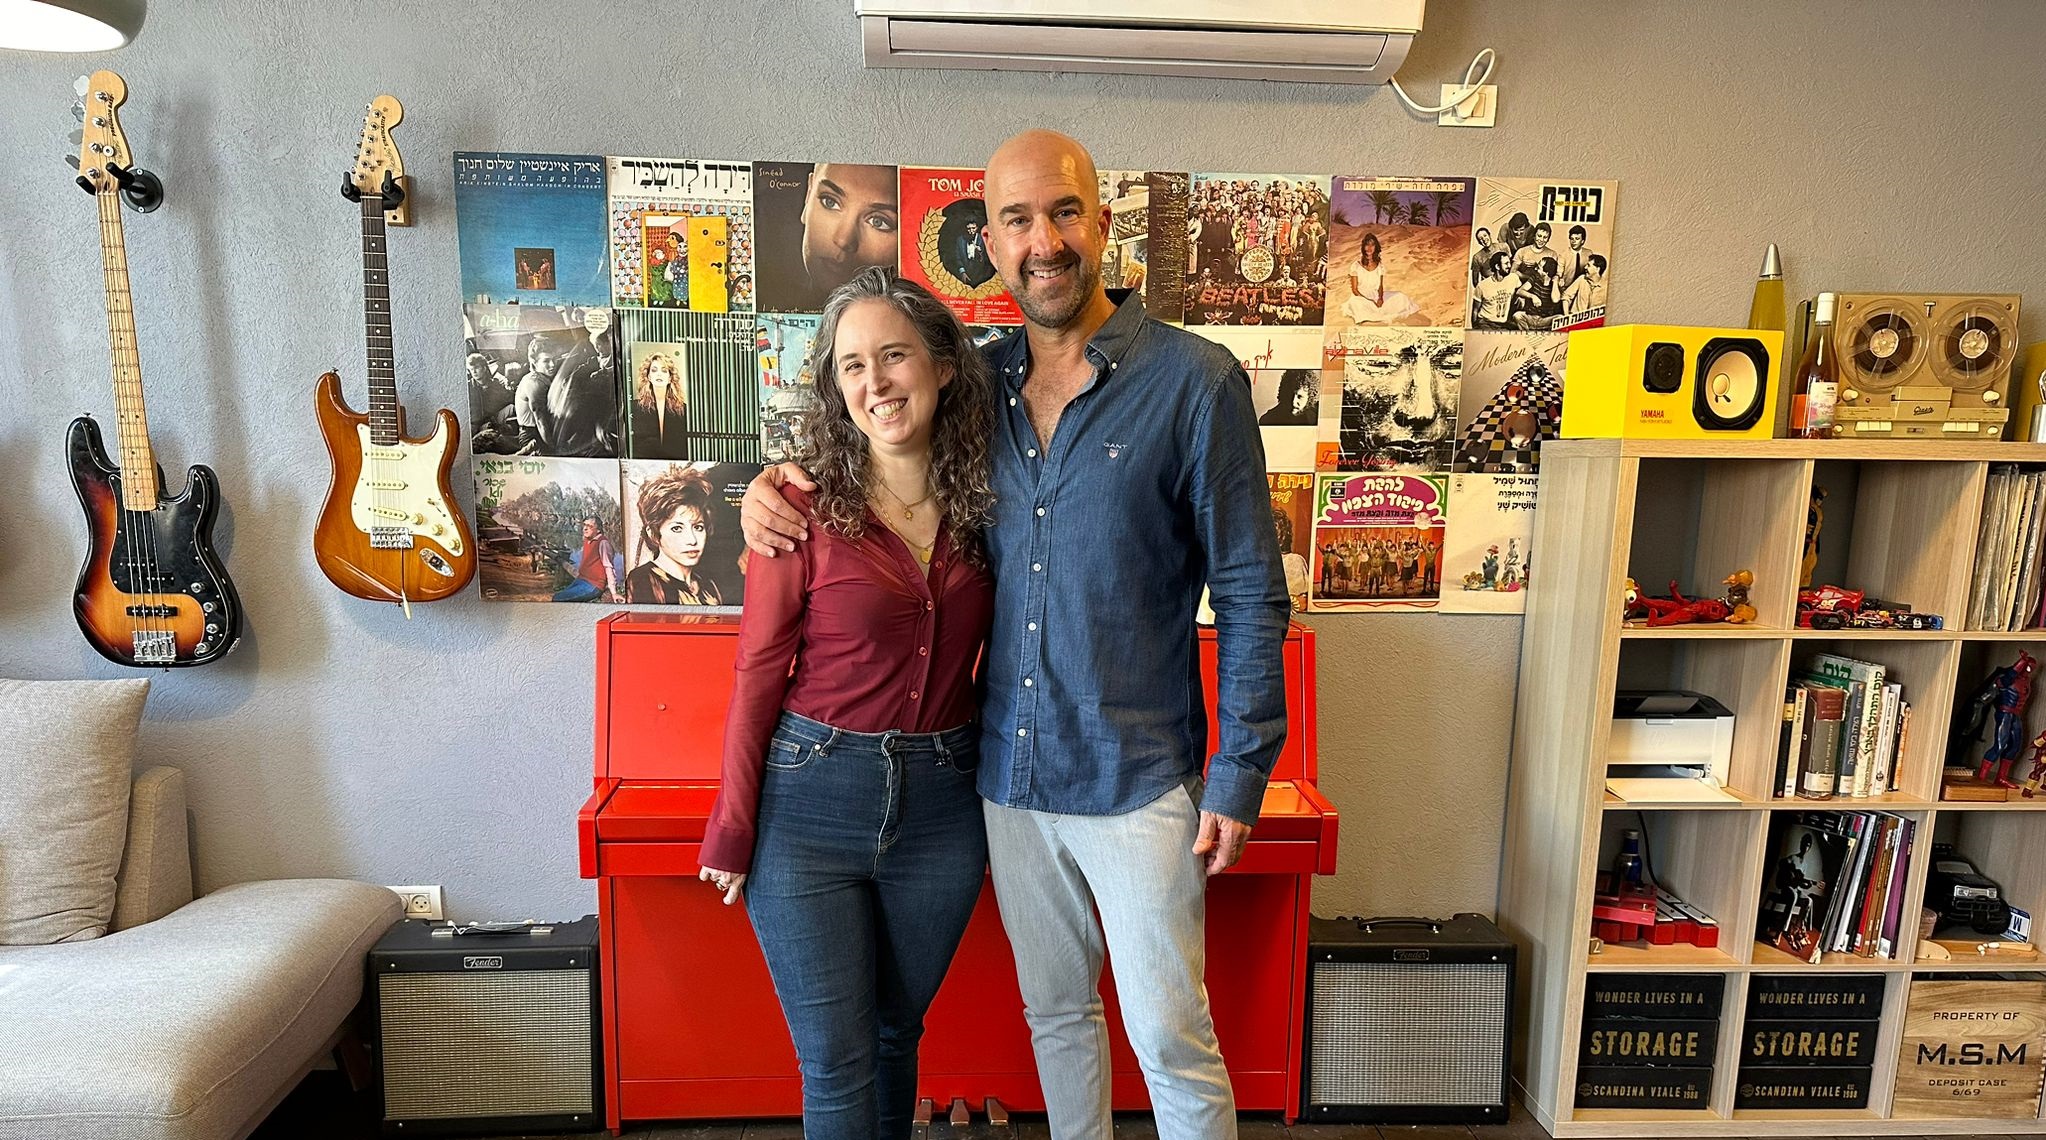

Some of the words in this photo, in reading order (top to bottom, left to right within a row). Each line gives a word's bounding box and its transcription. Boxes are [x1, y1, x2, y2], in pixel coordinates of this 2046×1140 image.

[458, 158, 482, 172] חנוך
[486, 154, 515, 170] שלום
[520, 160, 569, 174] איינשטיין
[573, 162, 600, 175] אריק
[928, 178, 962, 192] TOM
[1539, 186, 1603, 222] כוורת
[1200, 286, 1322, 309] BEATLES
[480, 308, 519, 328] a-ha
[1571, 306, 1606, 323] בהופעה
[714, 318, 755, 330] סנדרה
[1553, 316, 1570, 329] חיה
[1468, 343, 1526, 377] Modern
[1641, 410, 1665, 418] YAMAHA
[1316, 450, 1360, 467] Forever
[1361, 451, 1397, 468] Young
[519, 460, 546, 475] יוסי
[1363, 477, 1405, 492] להקת
[1341, 493, 1385, 514] הצפון
[1387, 493, 1424, 512] פיקוד
[1873, 671, 1883, 690] קום
[1867, 693, 1880, 728] התהלך
[1864, 728, 1876, 755] בארץ
[465, 958, 500, 968] Fender
[1595, 991, 1641, 1004] WONDER
[1645, 992, 1676, 1004] LIVES
[1680, 993, 1693, 1004] IN
[1697, 993, 1704, 1004] A
[1759, 992, 1804, 1004] WONDER
[1807, 993, 1839, 1004] LIVES
[1842, 993, 1855, 1004] IN
[1858, 993, 1866, 1004] A
[1933, 1012, 1999, 1020] PROPERTY
[2003, 1012, 2020, 1020] OF
[1590, 1031, 1699, 1057] STORAGE
[1753, 1031, 1859, 1057] STORAGE
[1916, 1043, 2027, 1065] M.S.M
[1928, 1079, 1976, 1087] DEPOSIT
[1979, 1079, 2008, 1087] CASE
[1593, 1085, 1645, 1096] SCANDINA
[1650, 1086, 1681, 1097] VIALE
[1755, 1086, 1805, 1097] SCANDINA
[1811, 1086, 1841, 1097] VIALE
